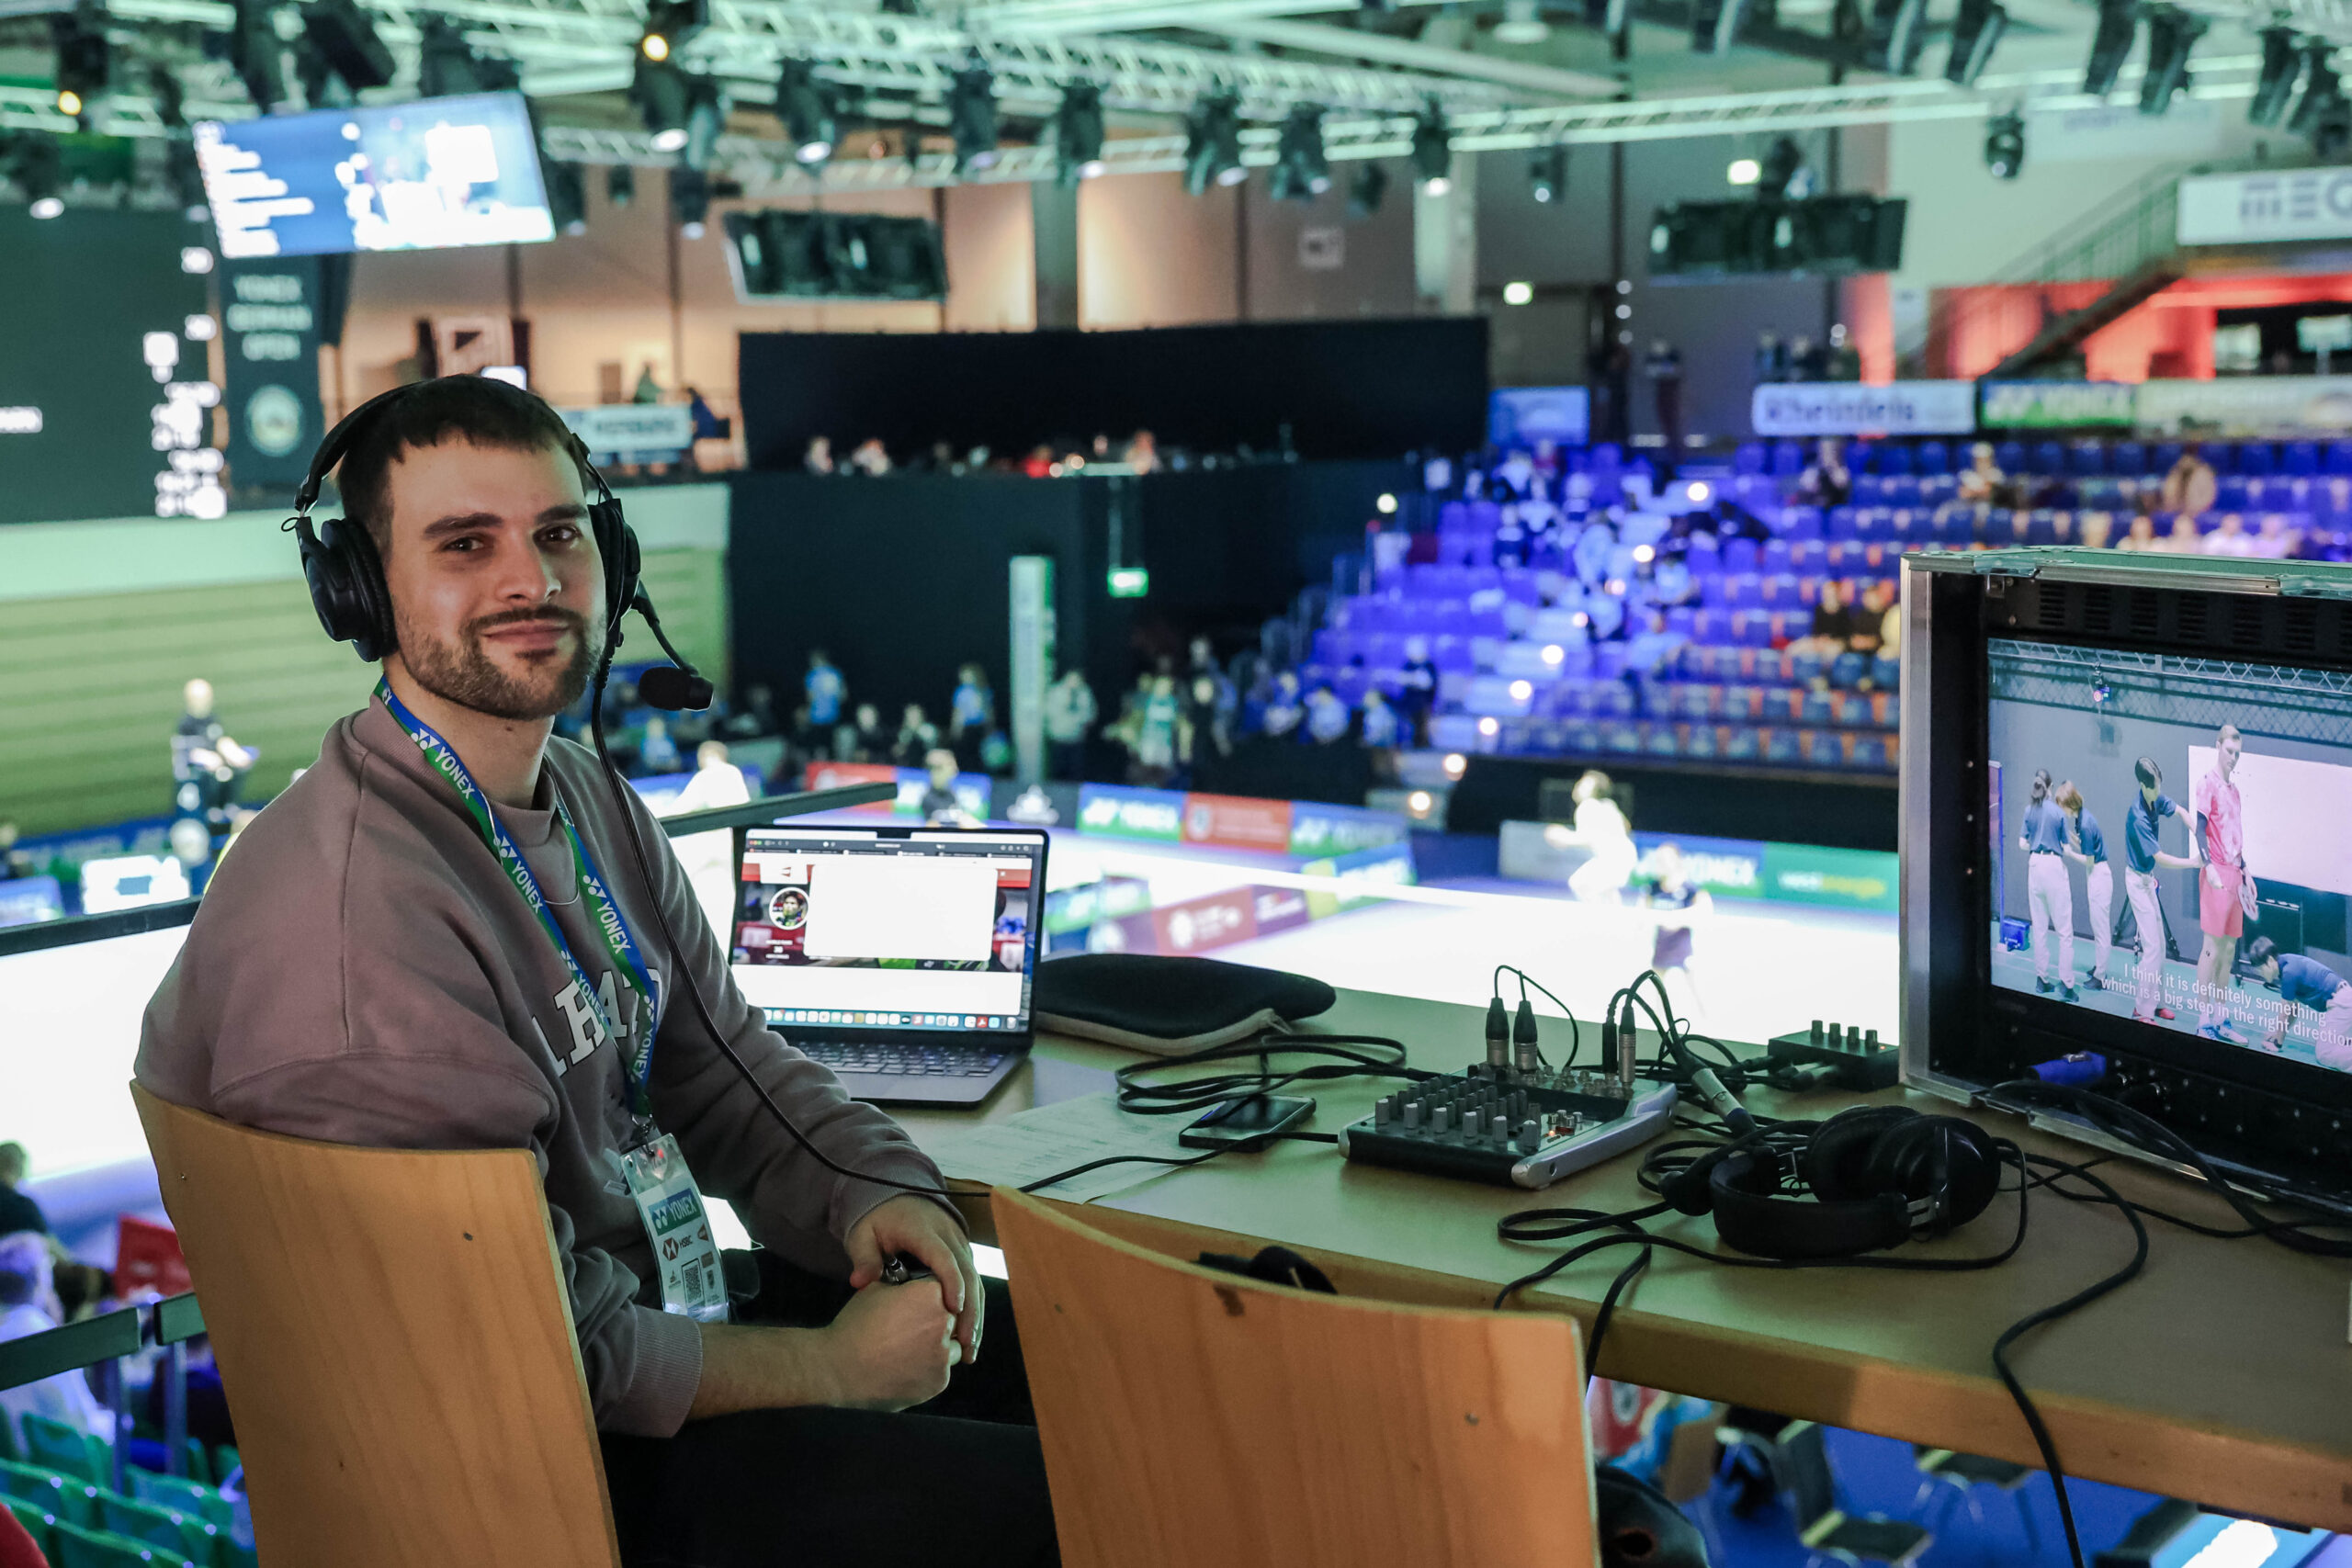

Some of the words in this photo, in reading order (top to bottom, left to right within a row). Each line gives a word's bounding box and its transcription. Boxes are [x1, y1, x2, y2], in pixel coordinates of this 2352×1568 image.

[435, 746, 475, 799] YONEX
[512, 861, 542, 913] YONEX
[597, 901, 631, 954] YONEX
[577, 973, 605, 1021] YONEX
[2101, 978, 2136, 997] which
[2140, 987, 2150, 999] is
[2154, 990, 2161, 1002] a
[2164, 990, 2184, 1010] big
[2187, 996, 2214, 1015] step
[2218, 1002, 2230, 1019] in
[2233, 1007, 2255, 1024] the
[2258, 1011, 2290, 1036] right
[2123, 963, 2129, 977] I
[2132, 965, 2163, 986] think
[2165, 974, 2176, 988] it
[2177, 976, 2189, 992] is
[2192, 979, 2252, 1009] definitely
[2256, 996, 2327, 1027] something
[669, 1194, 696, 1222] YONEX
